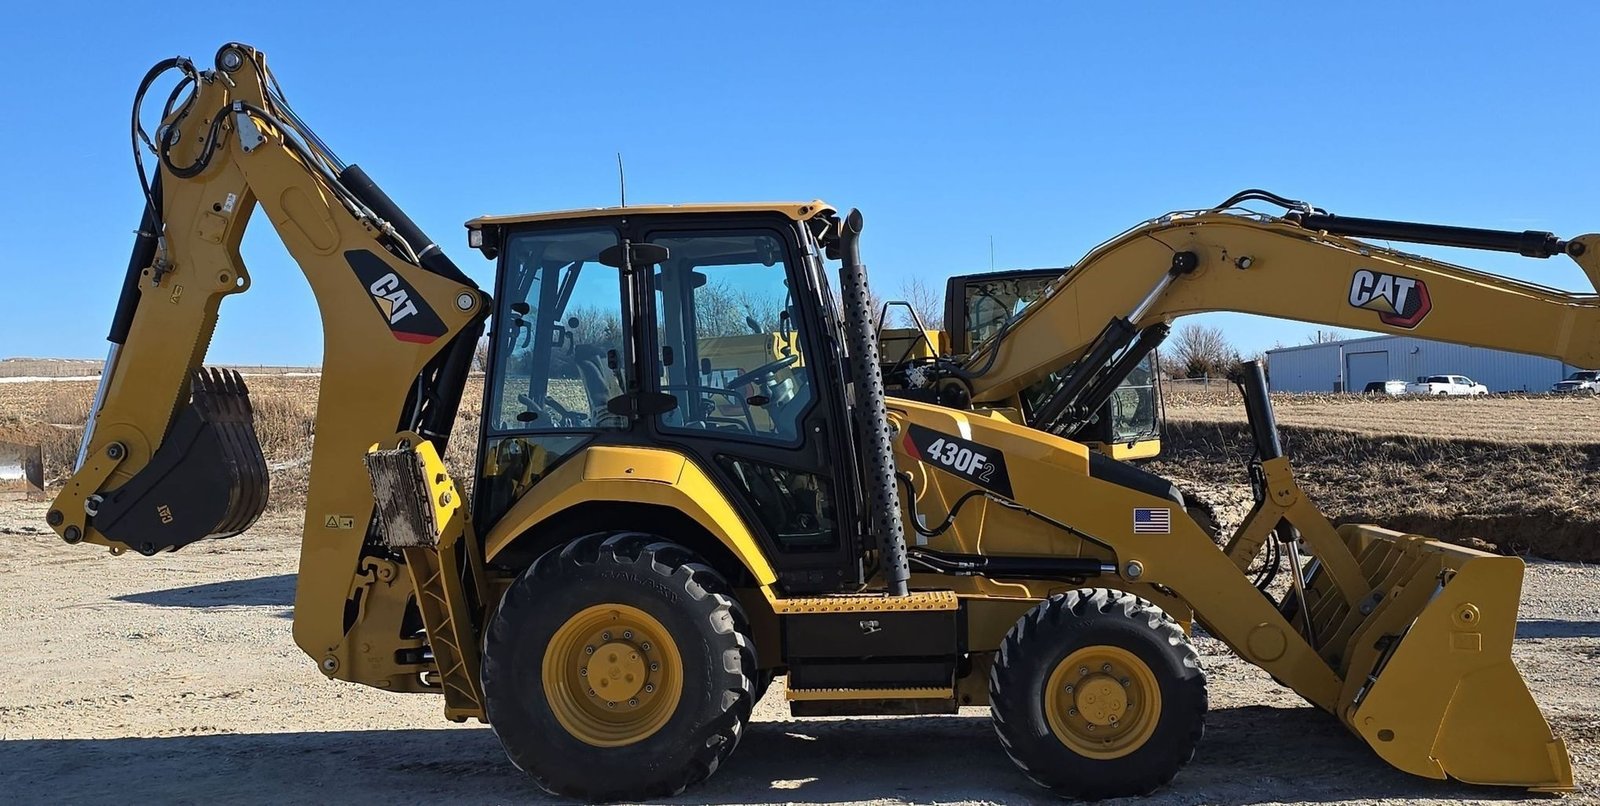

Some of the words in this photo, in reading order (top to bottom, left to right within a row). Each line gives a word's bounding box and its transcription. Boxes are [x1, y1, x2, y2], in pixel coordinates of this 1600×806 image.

[370, 272, 418, 325] CAT
[1349, 270, 1416, 315] CAT
[926, 437, 995, 483] 430F2
[156, 504, 174, 524] CAT
